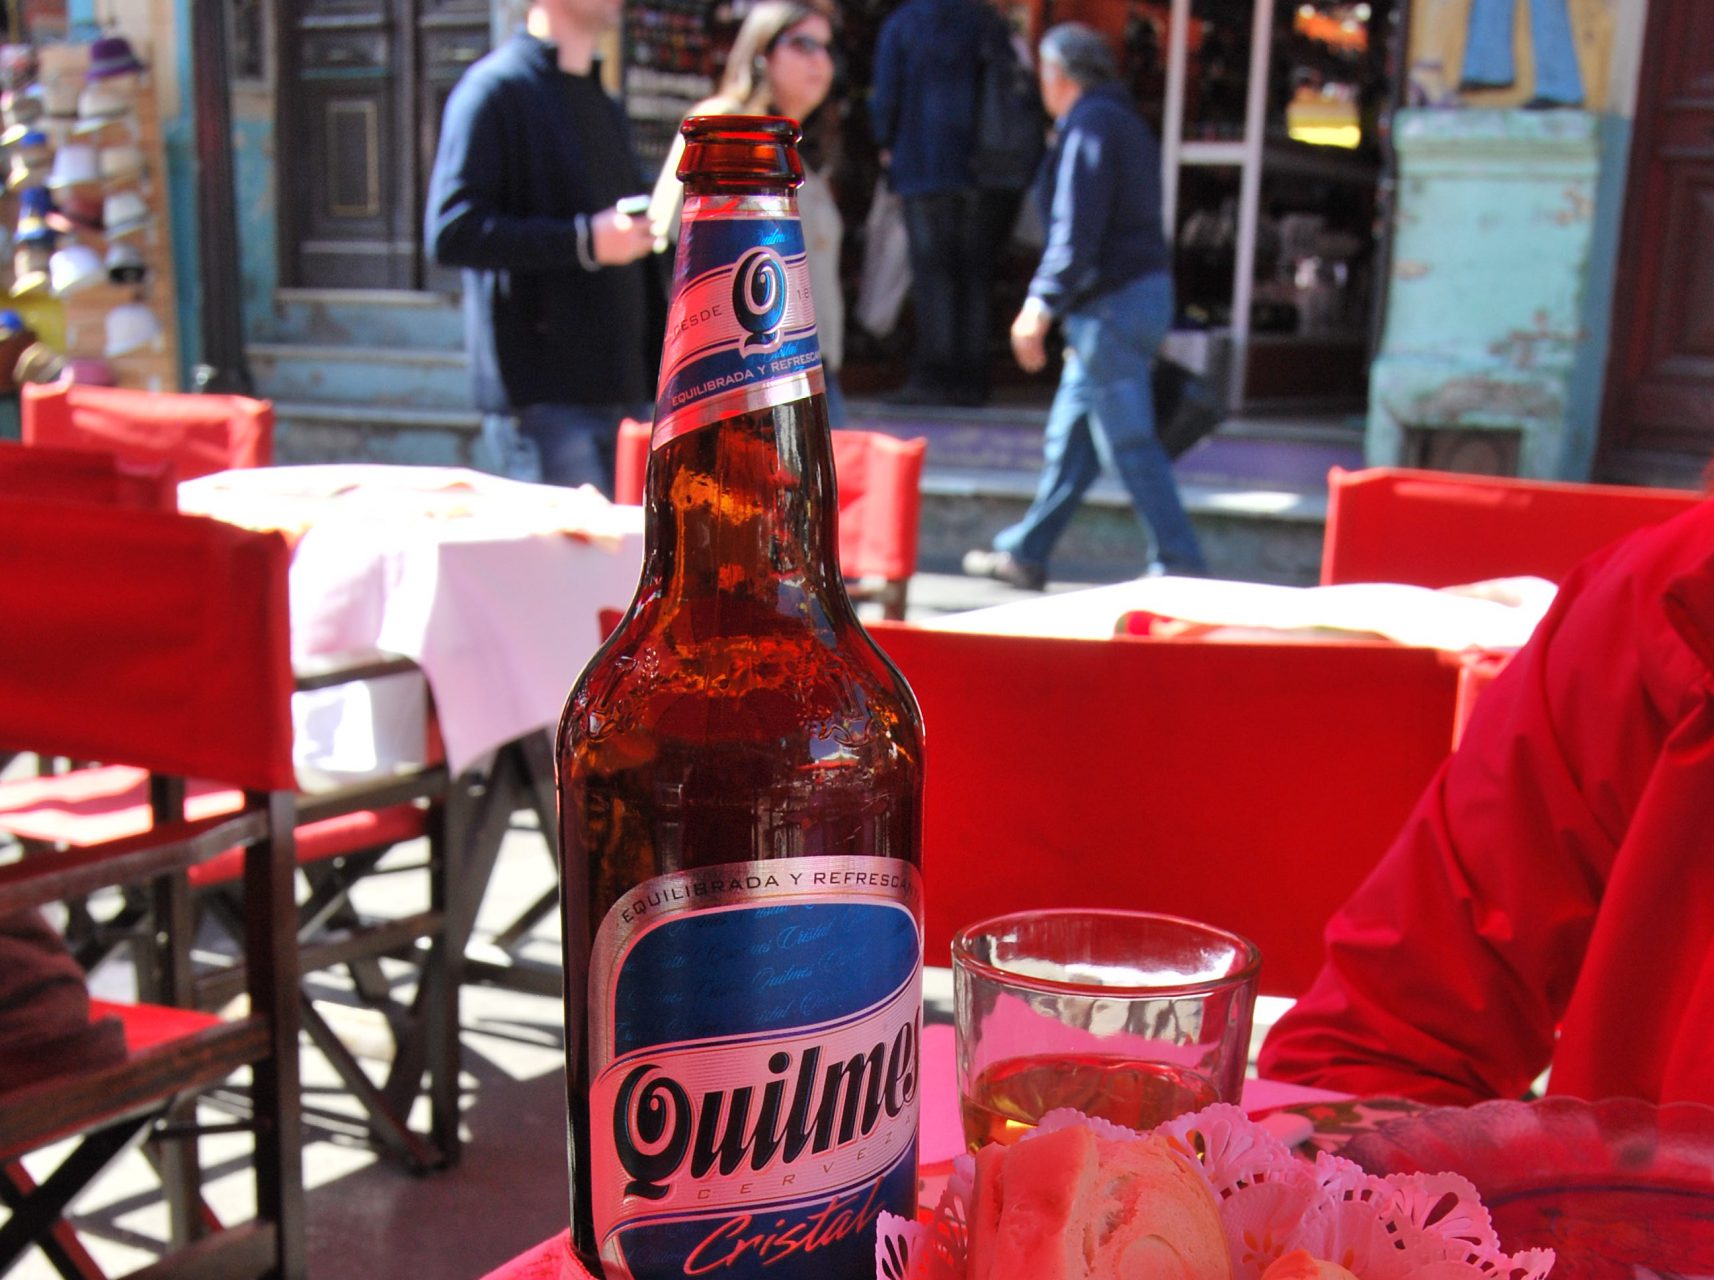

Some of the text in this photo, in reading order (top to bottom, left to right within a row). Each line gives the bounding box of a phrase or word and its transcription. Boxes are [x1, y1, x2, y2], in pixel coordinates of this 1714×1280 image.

[732, 251, 787, 348] Q
[671, 368, 754, 406] EQUILIBRADA
[757, 364, 766, 376] Y
[621, 875, 778, 924] EQUILIBRADA
[789, 873, 803, 886] Y
[612, 1005, 920, 1200] Quilmes
[697, 1114, 913, 1200] CERVEZA
[682, 1174, 887, 1276] Cristal
